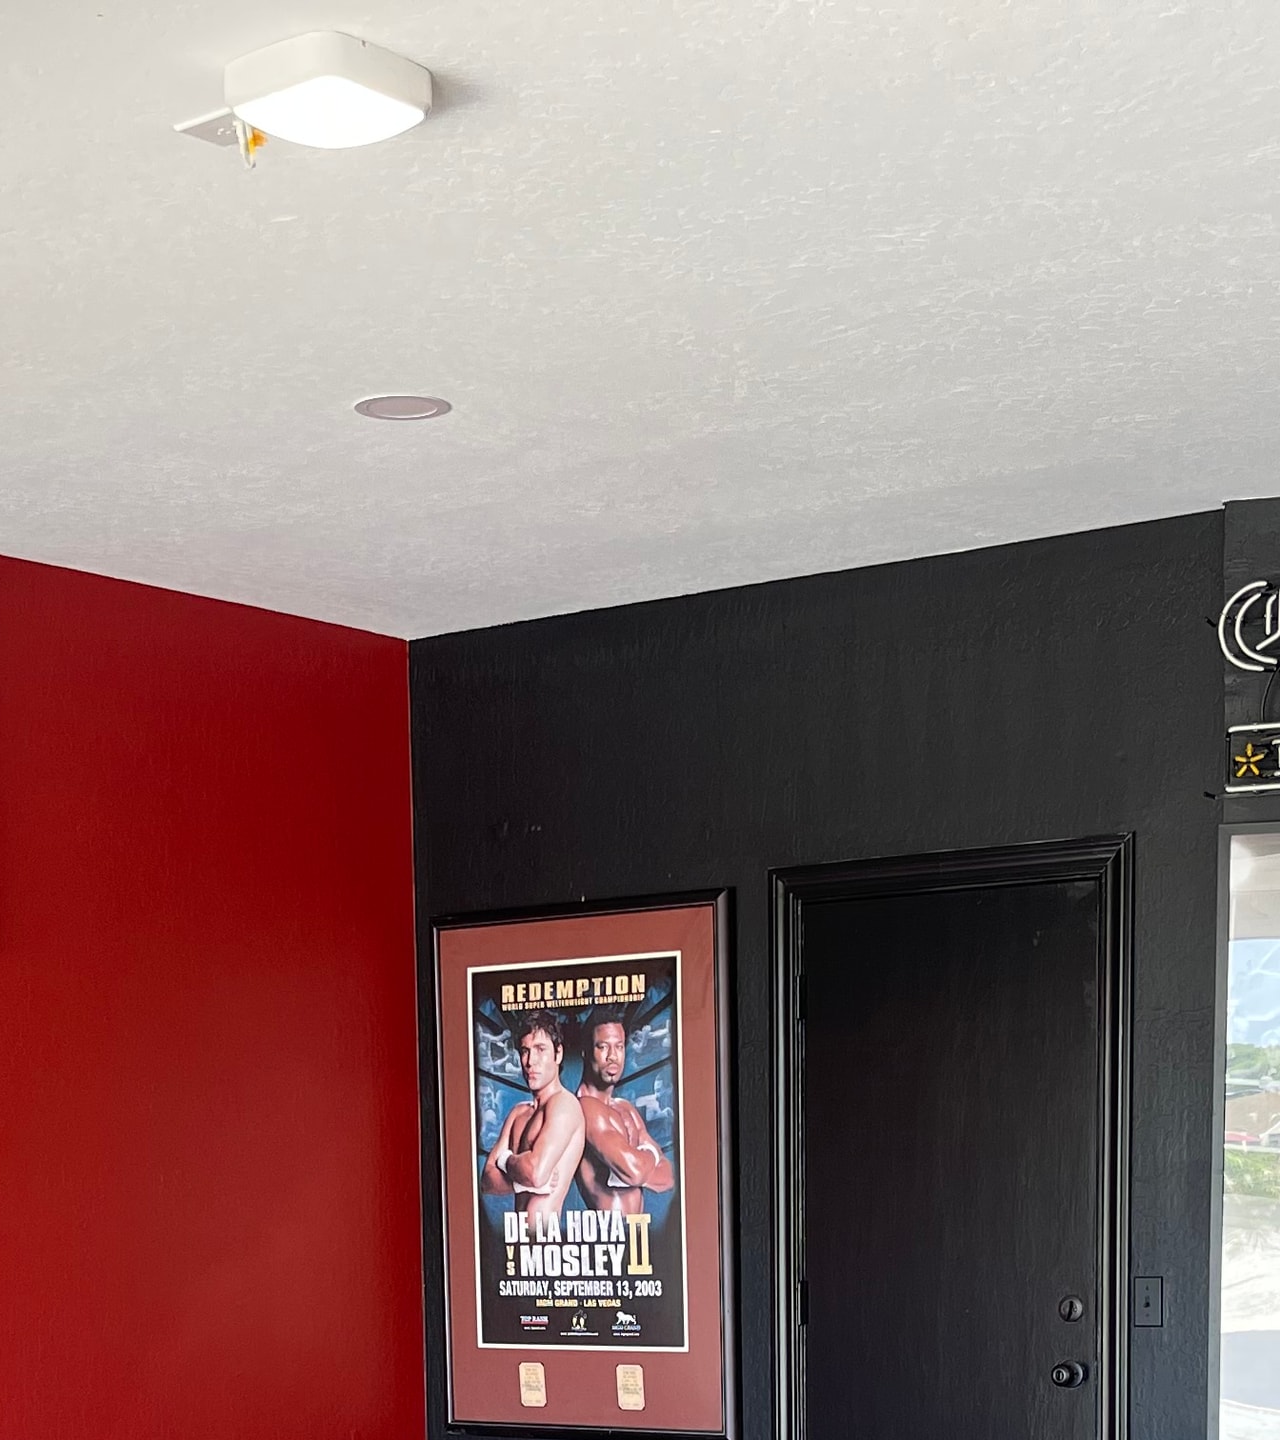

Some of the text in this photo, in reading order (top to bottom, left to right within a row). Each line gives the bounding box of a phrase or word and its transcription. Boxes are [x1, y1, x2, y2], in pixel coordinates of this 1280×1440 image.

[501, 974, 646, 1003] REDEMPTION
[502, 993, 646, 1012] WORLD SUPER WELTERWEIGHT CHAMPIONSHIP
[504, 1210, 653, 1275] DE LA HOYA II
[520, 1244, 626, 1277] MOSLEY
[499, 1280, 662, 1299] SATURDAY, SEPTEMBER 13, 2003
[536, 1299, 621, 1307] MGM GRAND LAS VEGAS
